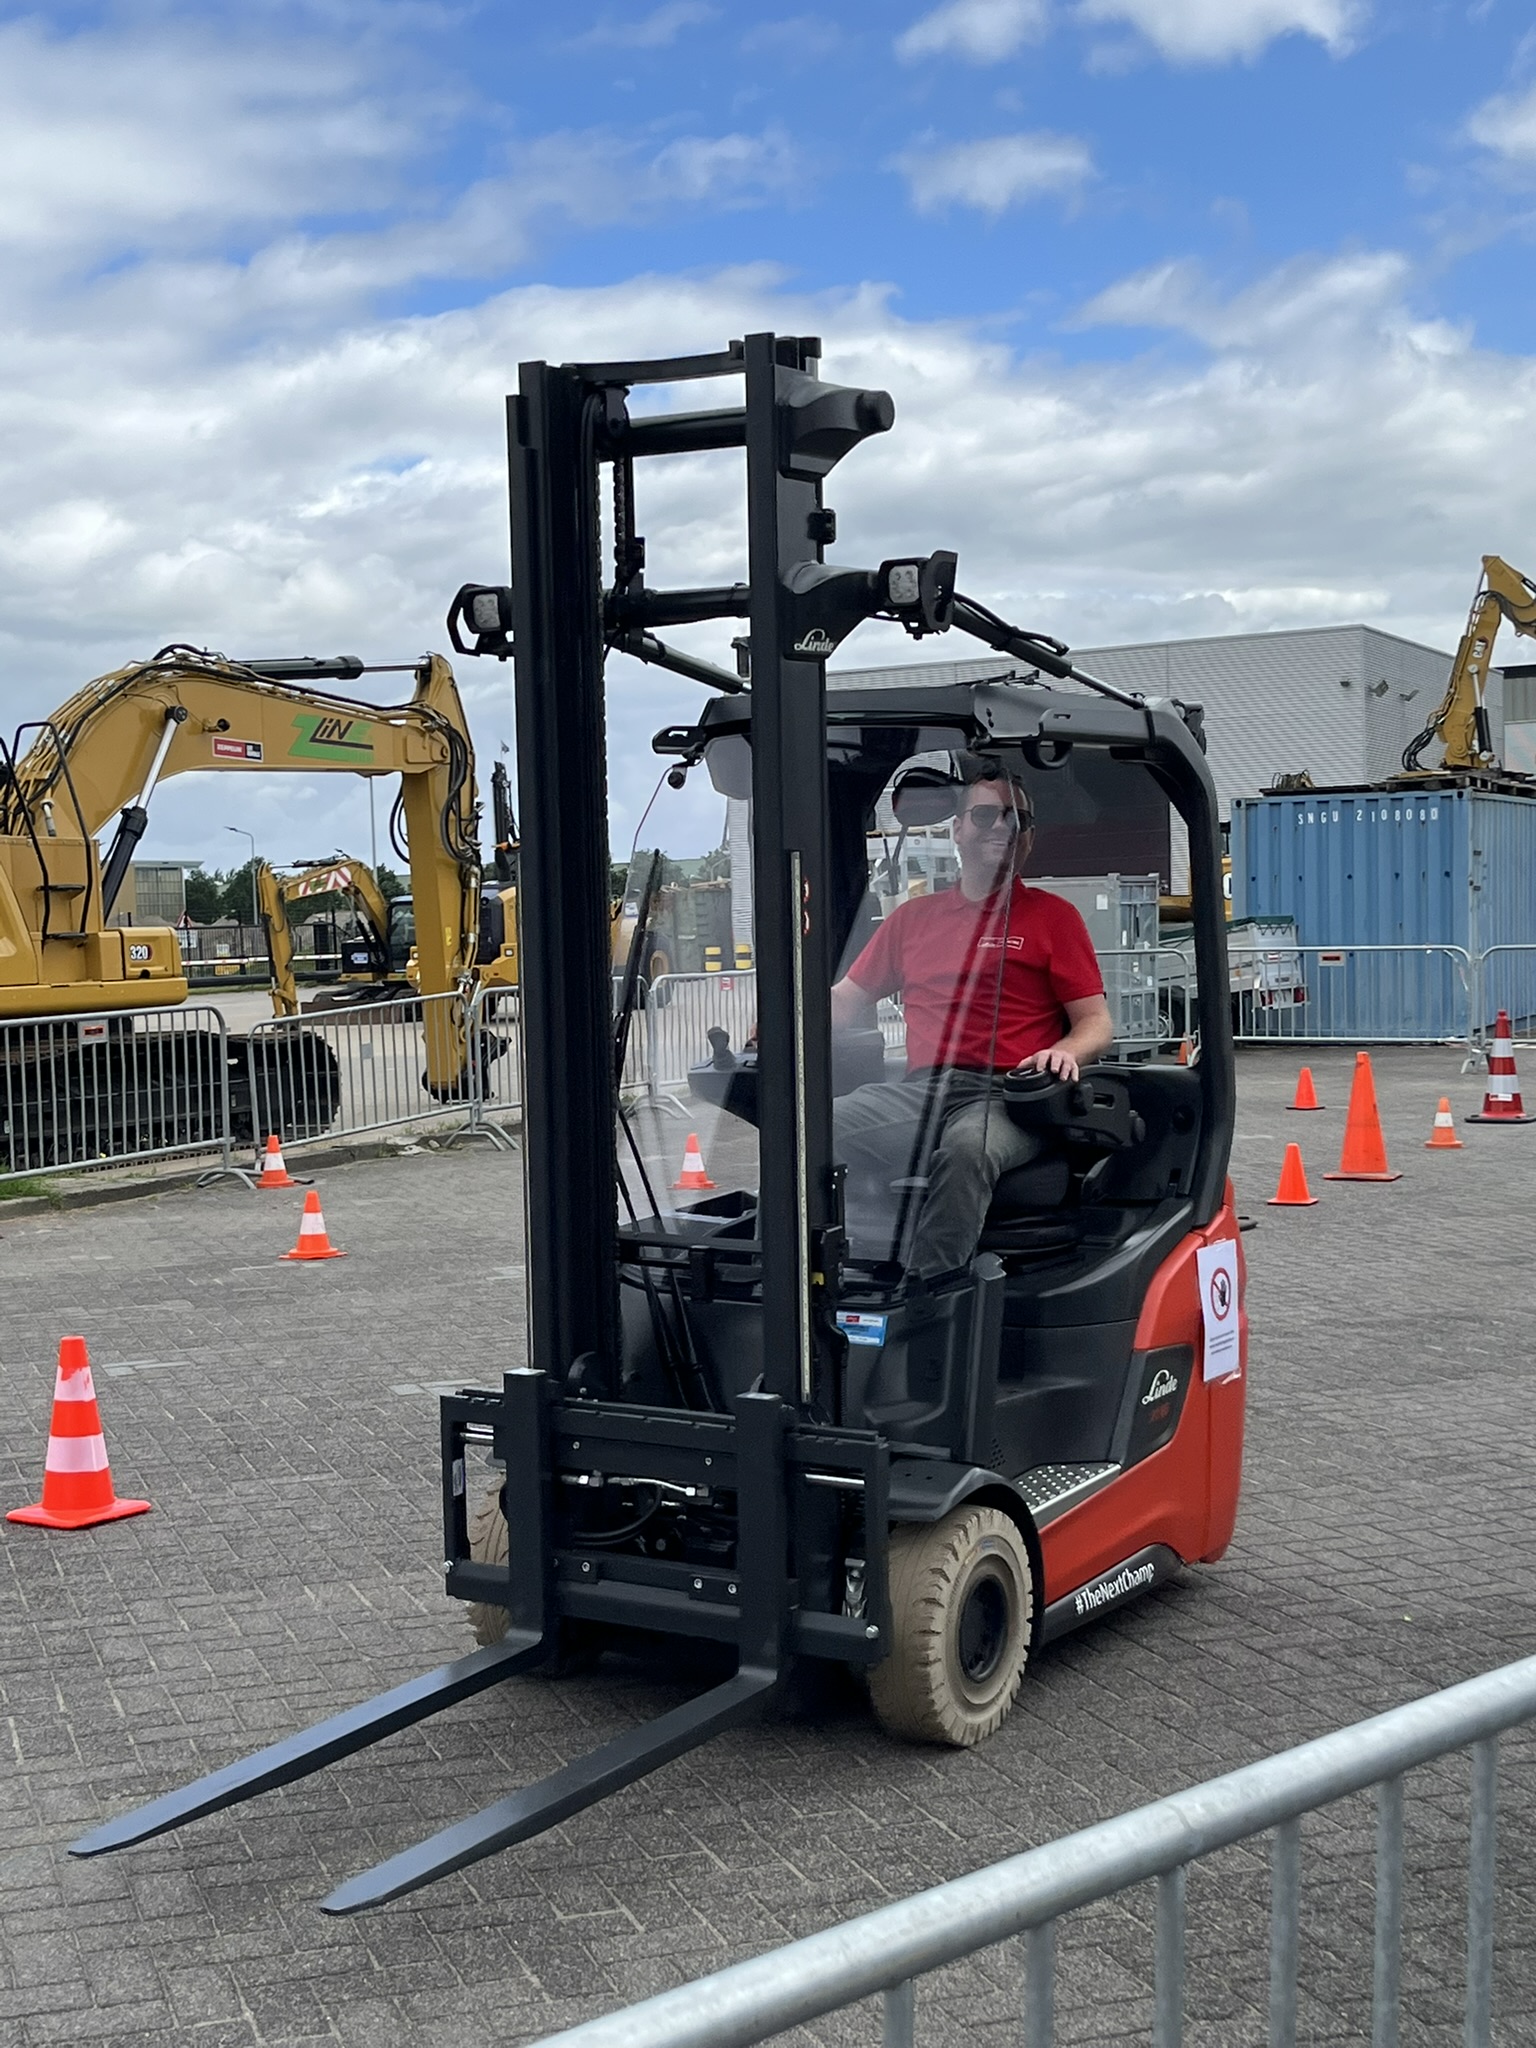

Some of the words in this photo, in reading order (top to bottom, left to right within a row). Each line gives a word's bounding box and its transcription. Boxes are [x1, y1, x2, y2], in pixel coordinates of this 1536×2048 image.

[793, 628, 834, 653] Linde
[1297, 810, 1339, 825] SNGU
[129, 945, 149, 960] 320
[1141, 1369, 1178, 1405] Linde
[1074, 1562, 1155, 1615] #TheNextChamp
